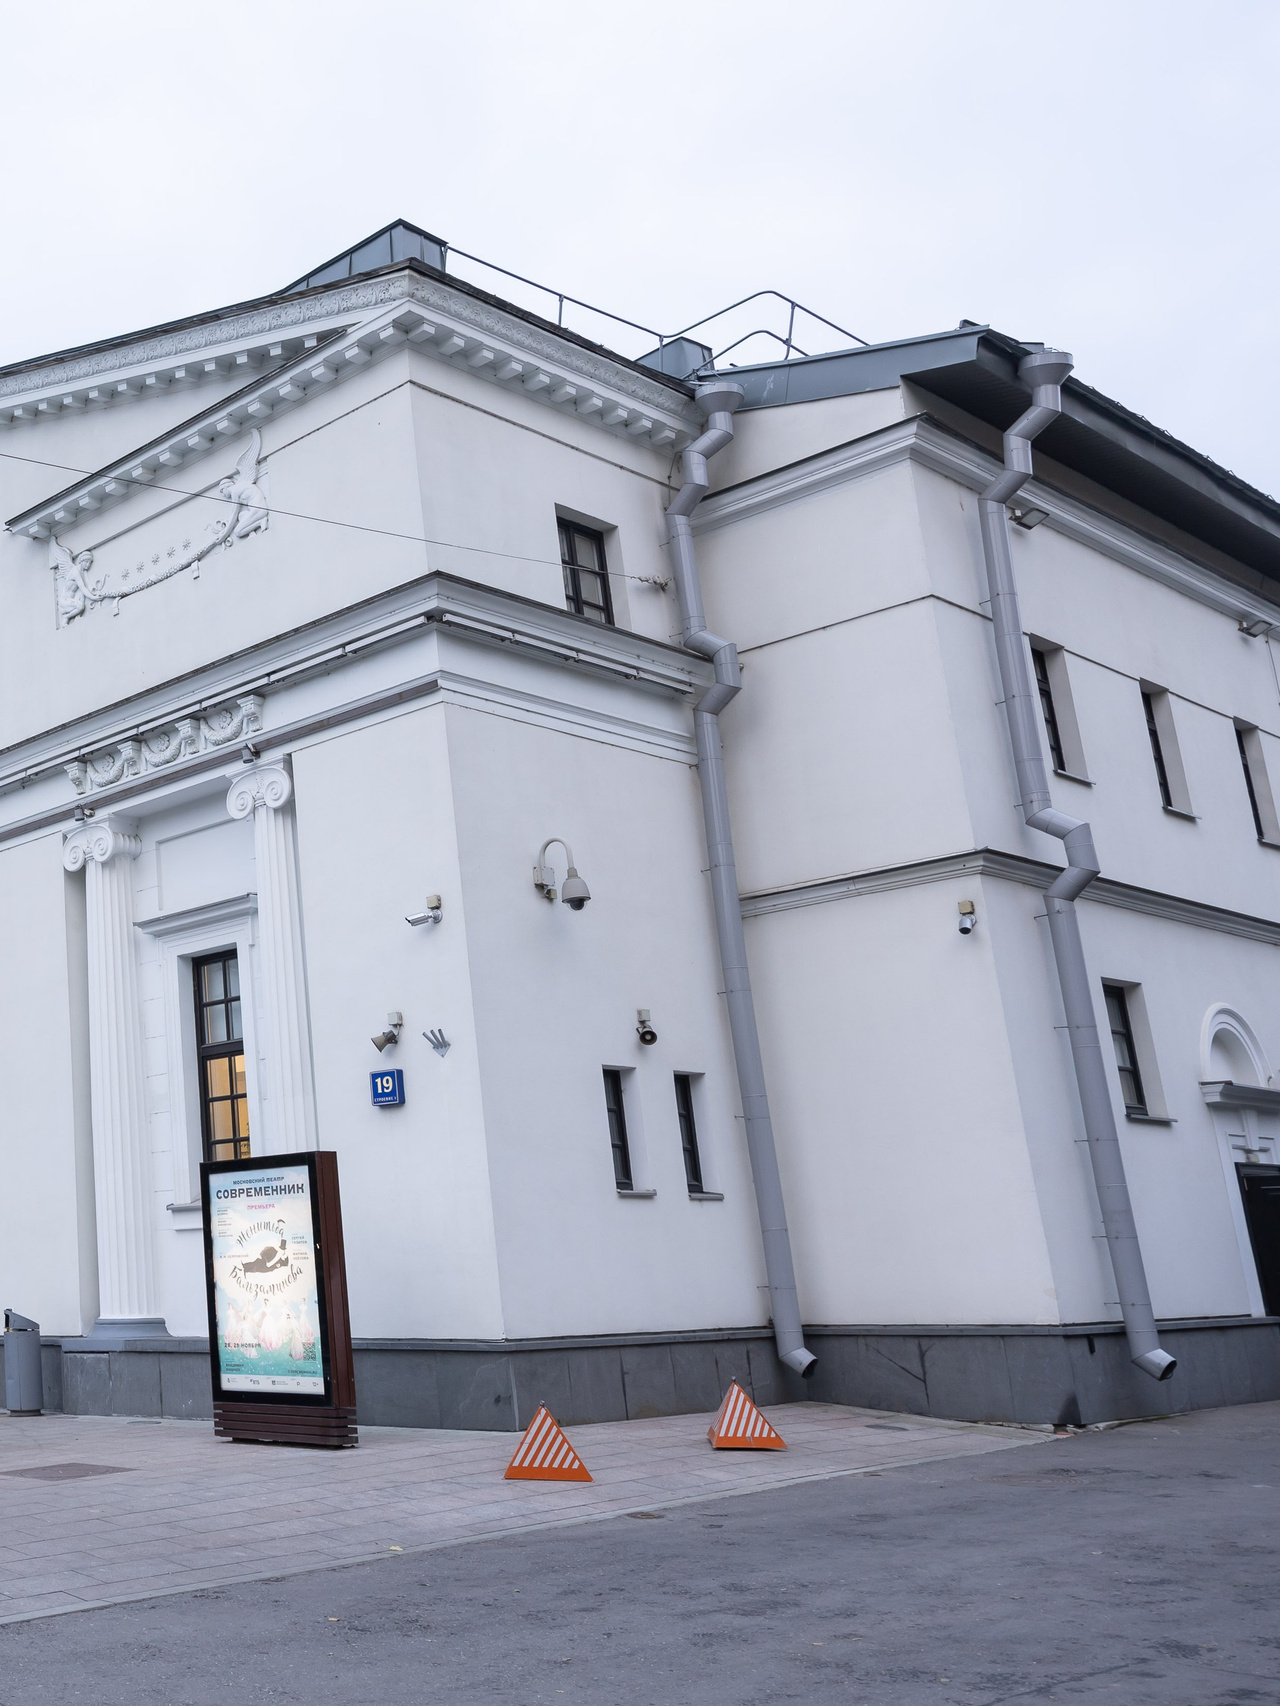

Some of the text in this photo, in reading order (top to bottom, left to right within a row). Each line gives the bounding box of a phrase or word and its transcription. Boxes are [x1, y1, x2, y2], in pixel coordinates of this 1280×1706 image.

[375, 1076, 393, 1094] 19
[232, 1177, 265, 1185] МОСКОВСКИЙ
[216, 1183, 305, 1200] СОВРЕМЕННИК
[247, 1203, 276, 1211] ПРЕМЬЕРА
